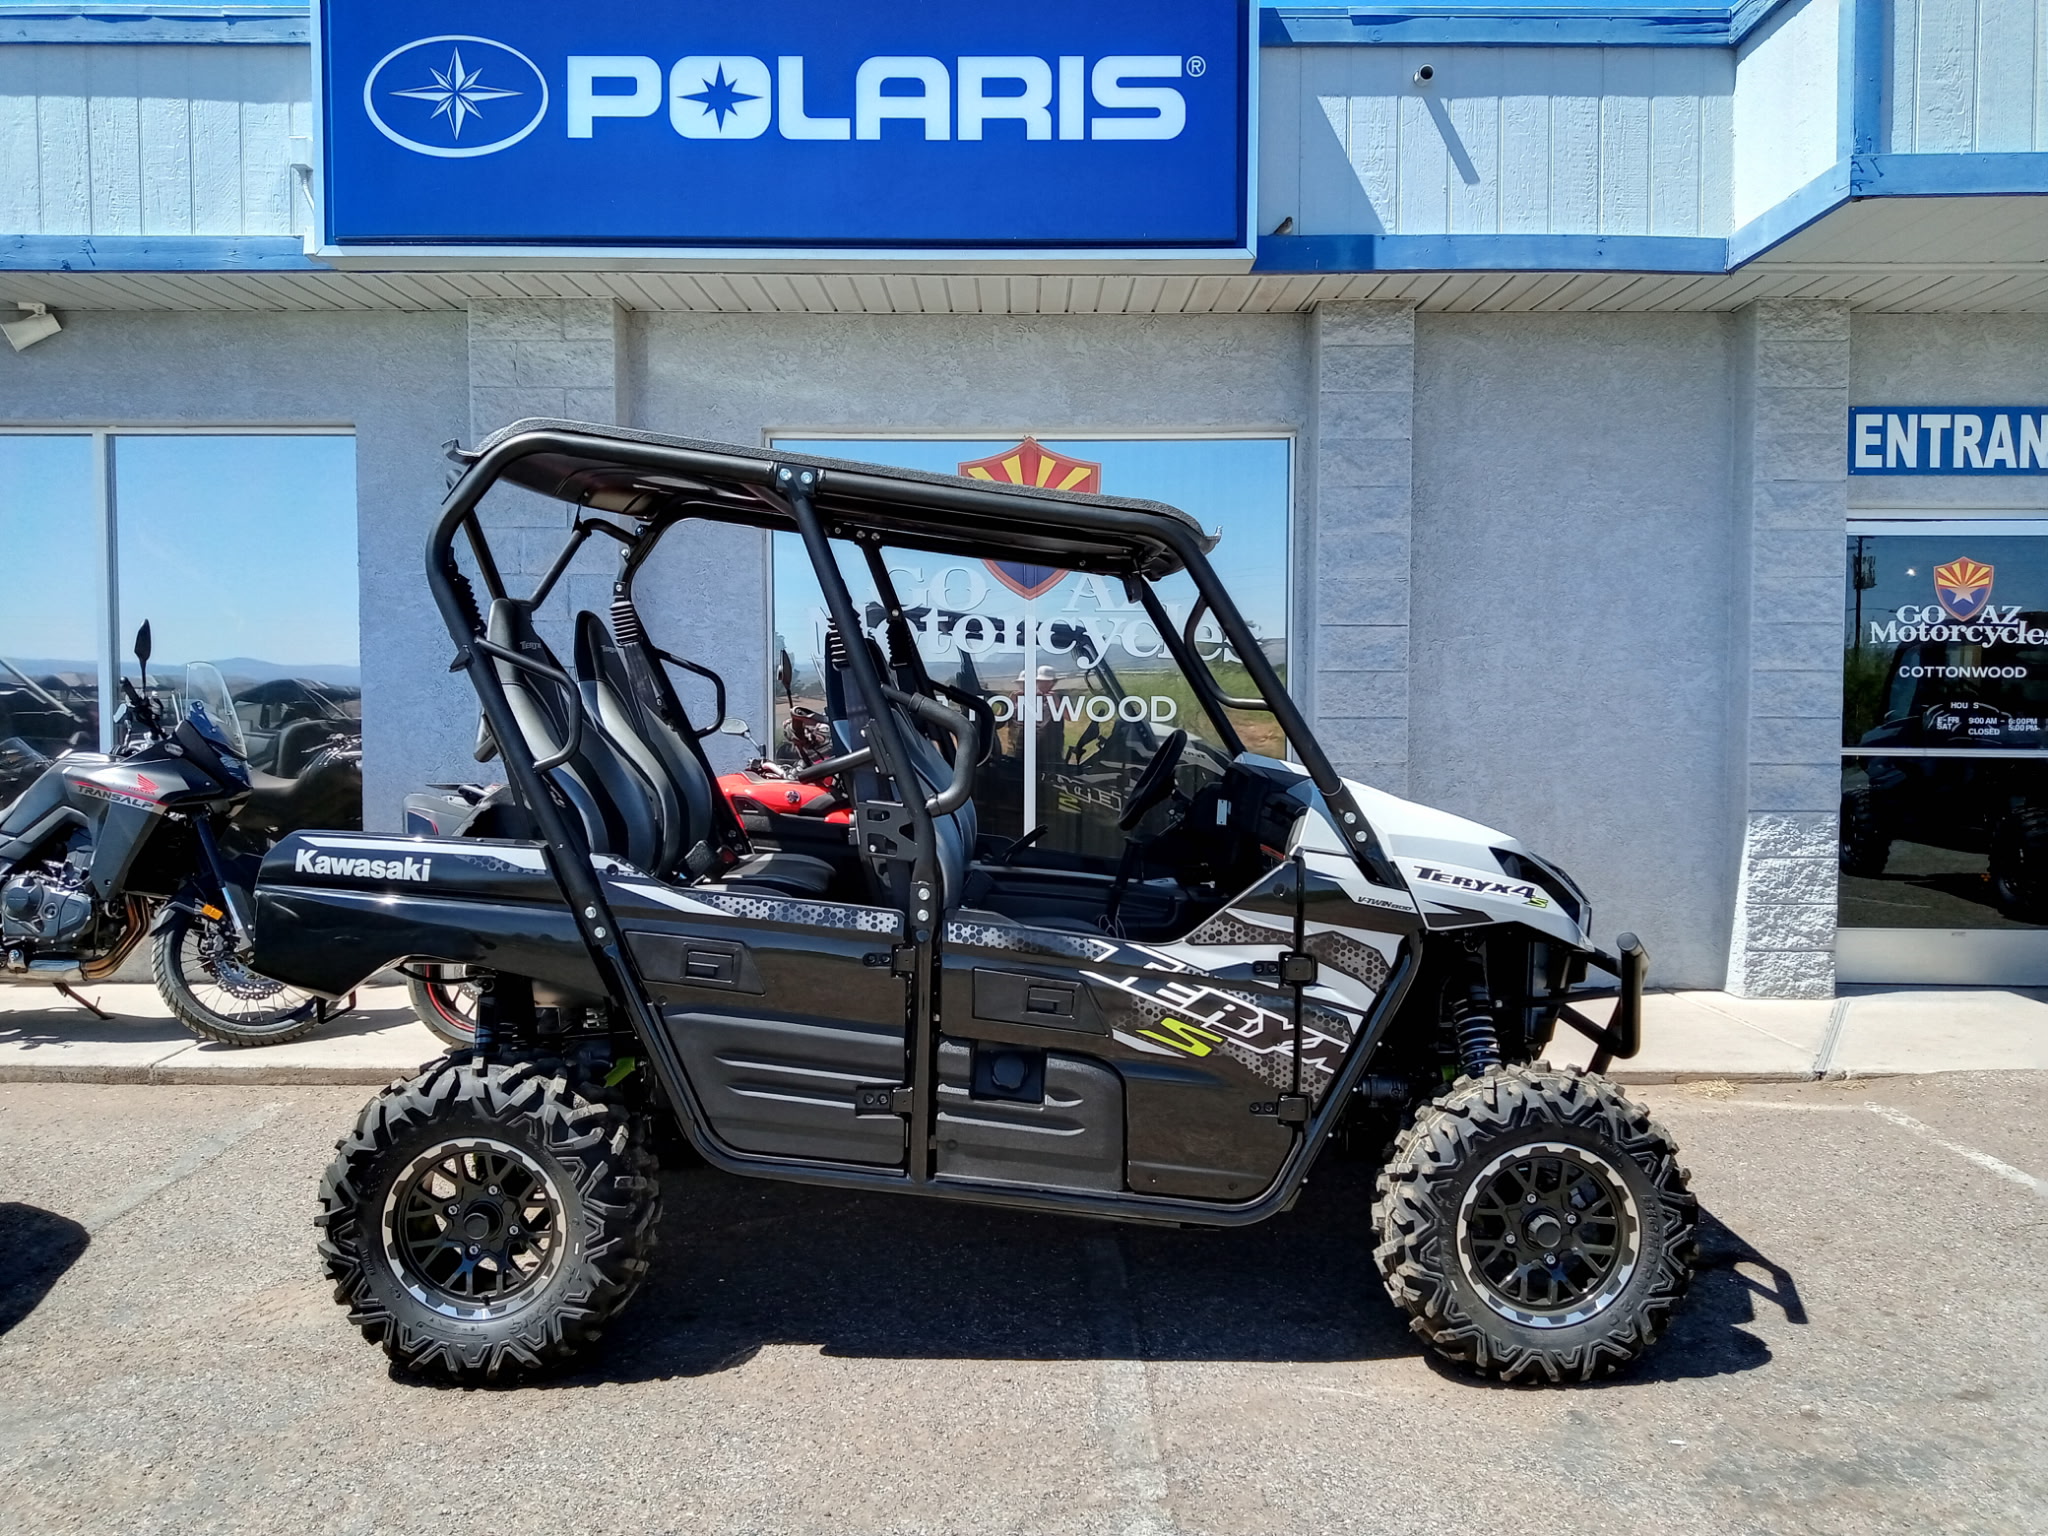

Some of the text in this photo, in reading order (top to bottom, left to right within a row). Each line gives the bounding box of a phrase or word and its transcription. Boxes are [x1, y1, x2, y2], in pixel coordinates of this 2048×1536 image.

[567, 55, 1187, 141] POLARIS
[1854, 413, 2048, 469] ENTRAN
[1896, 604, 2022, 624] GO AZ
[1899, 665, 2027, 678] COTTONWOOD
[78, 785, 154, 808] TRANSALP
[295, 849, 432, 882] Kawasaki
